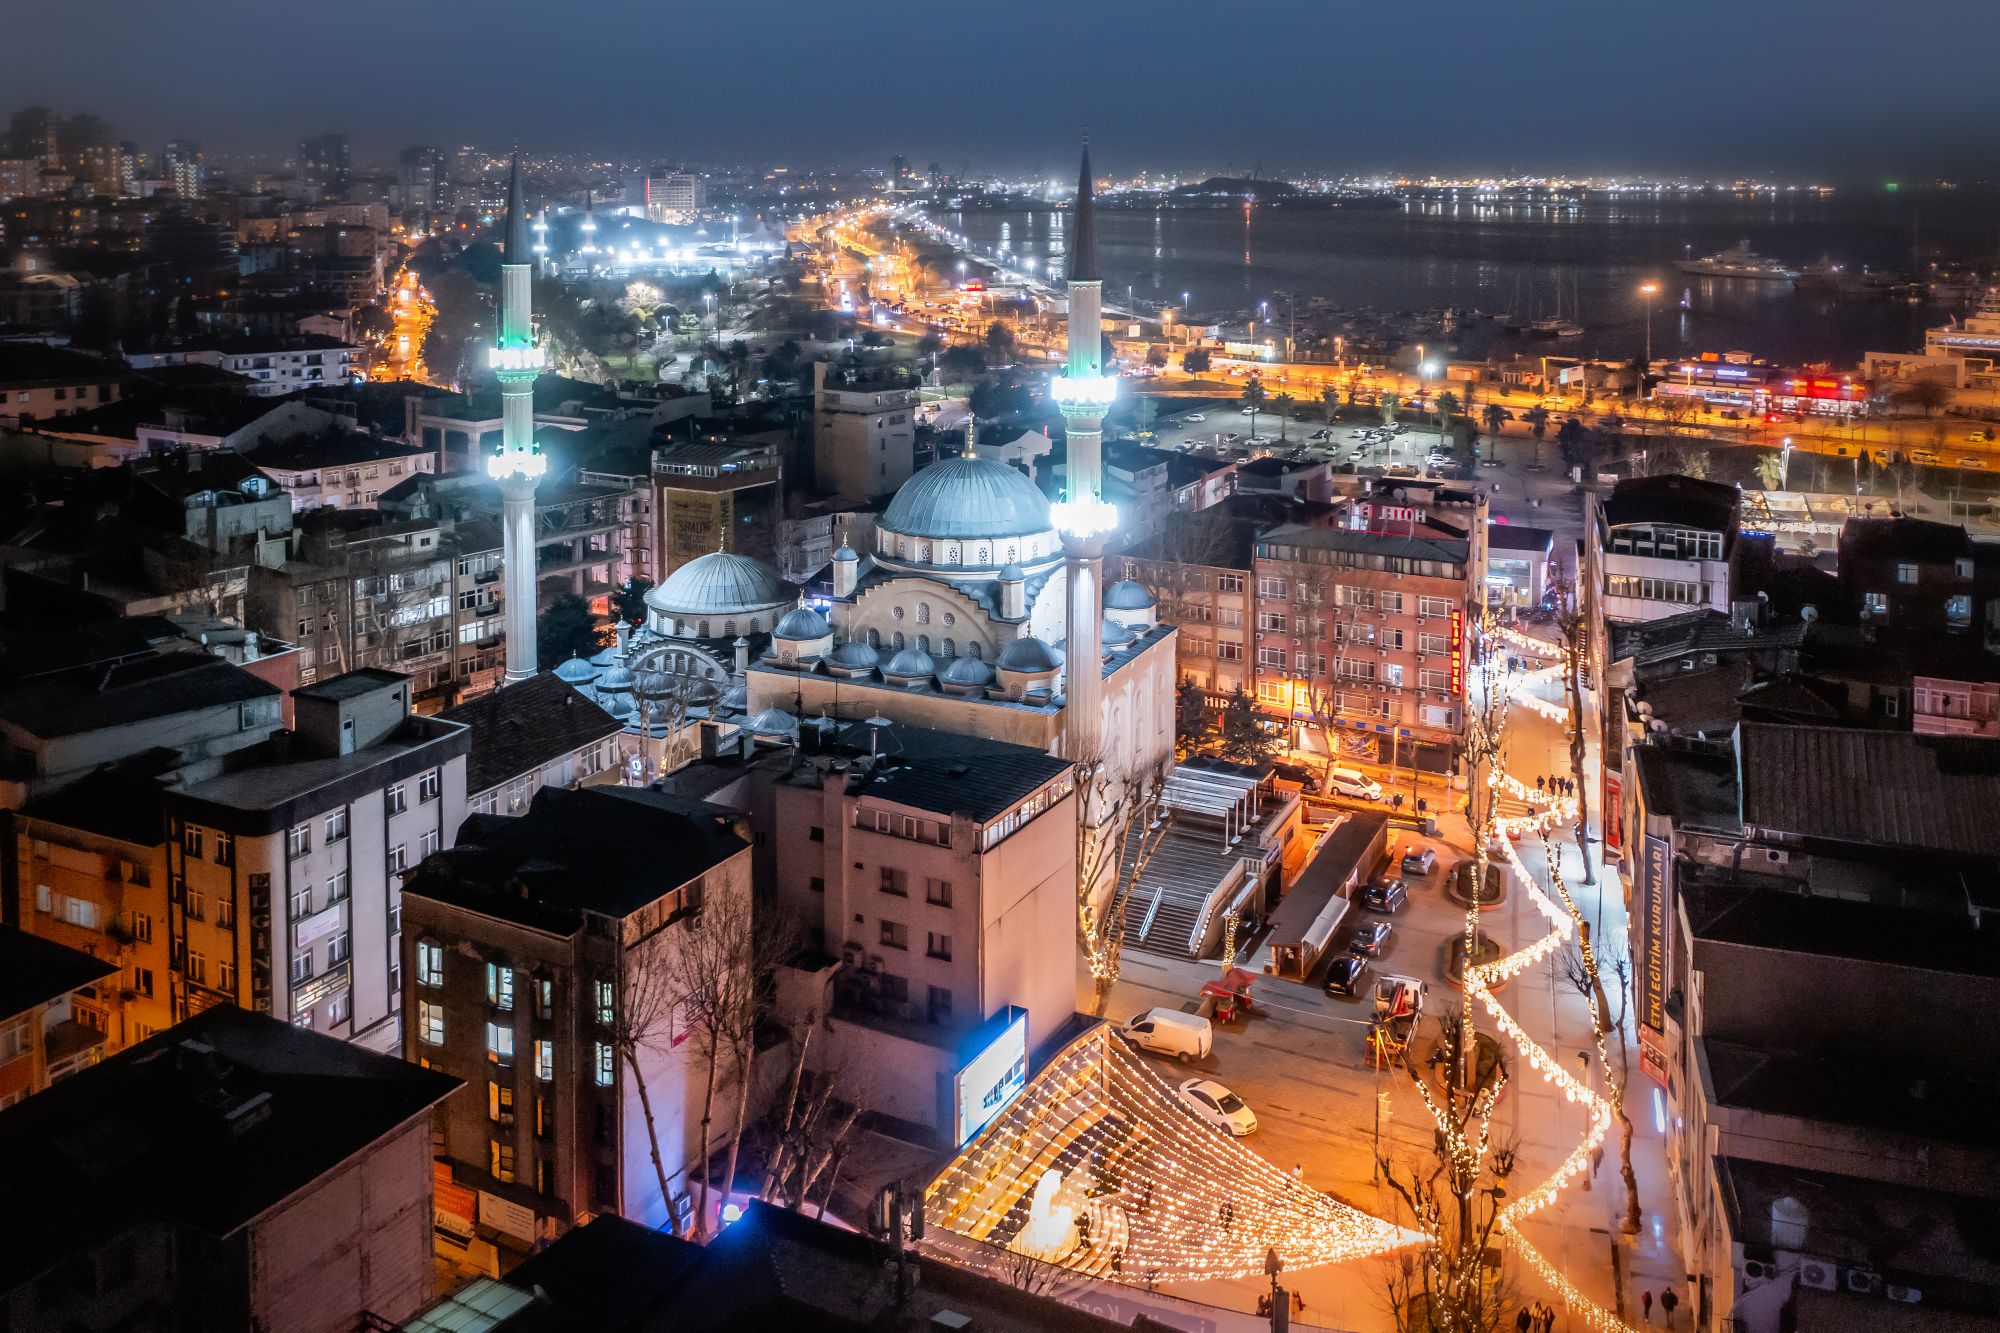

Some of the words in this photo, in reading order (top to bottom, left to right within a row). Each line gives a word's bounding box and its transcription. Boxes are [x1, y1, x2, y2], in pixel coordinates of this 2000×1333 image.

[1651, 845, 1663, 938] KURUMLARI
[1650, 940, 1662, 991] EĞİTİM
[1650, 992, 1661, 1030] ETKİ
